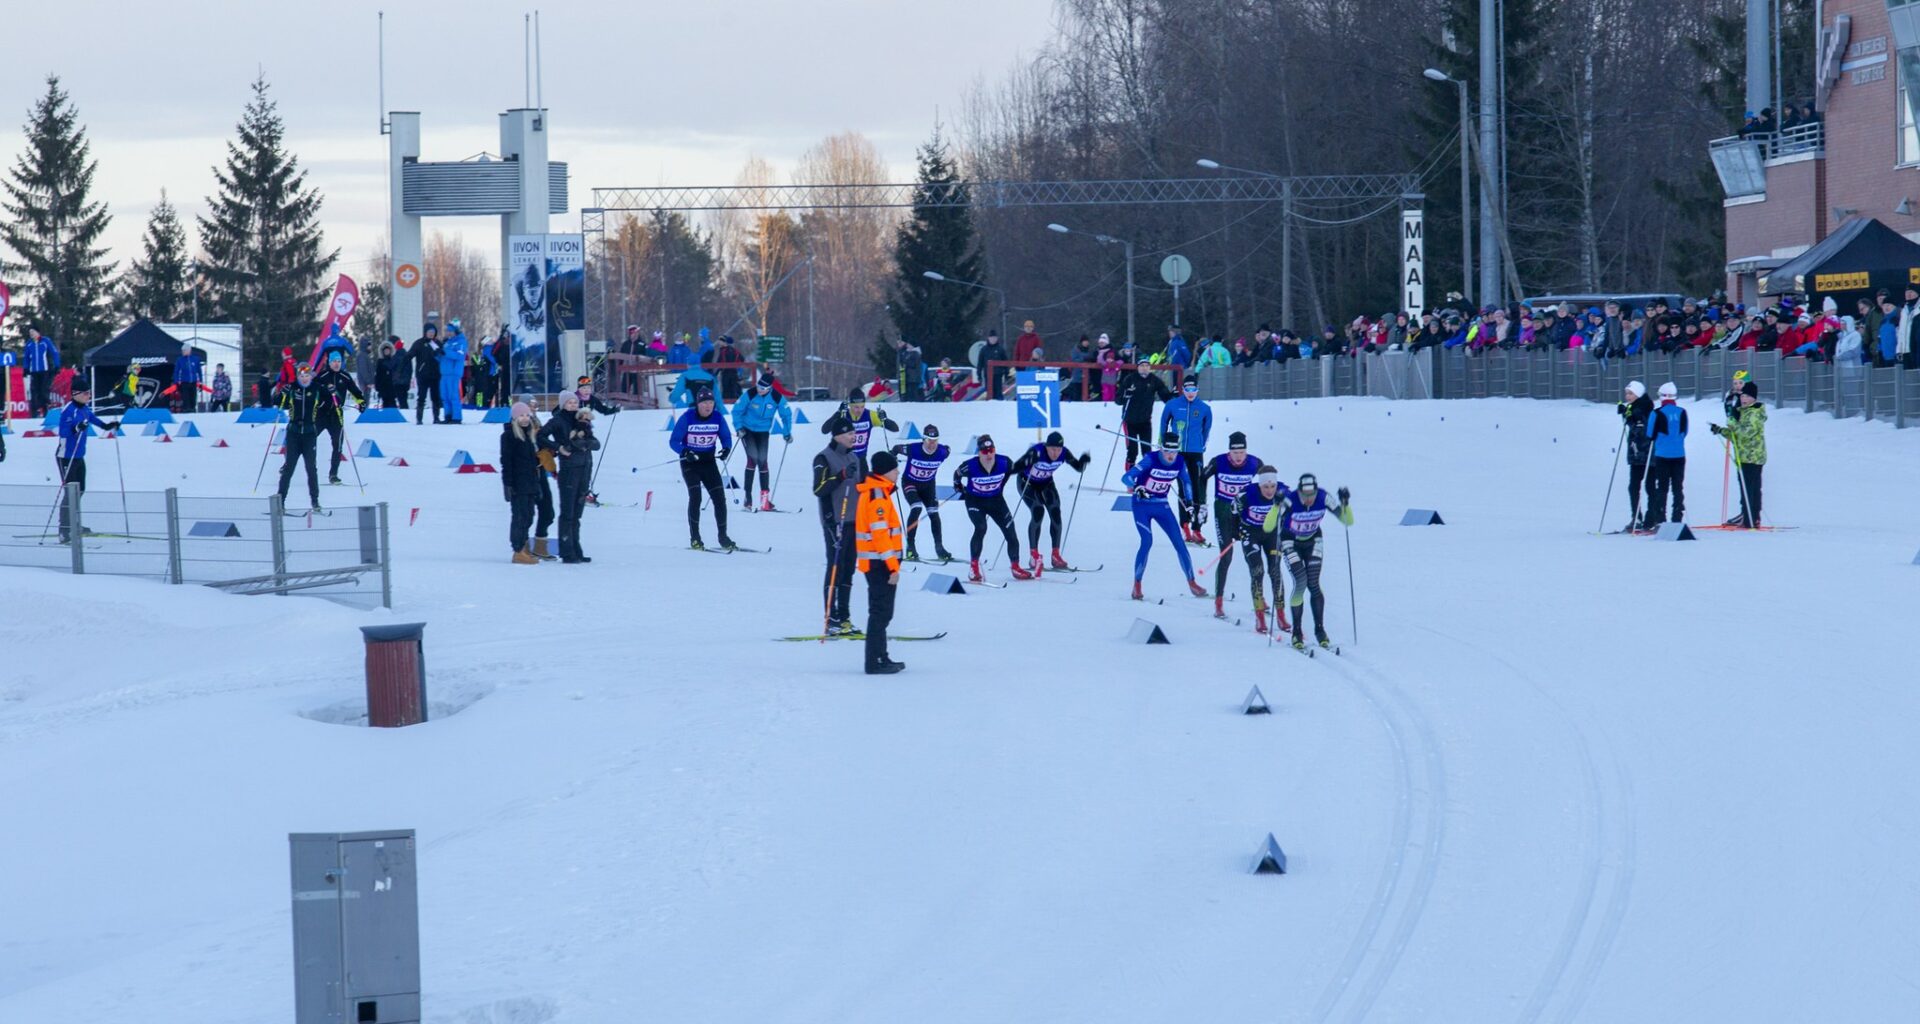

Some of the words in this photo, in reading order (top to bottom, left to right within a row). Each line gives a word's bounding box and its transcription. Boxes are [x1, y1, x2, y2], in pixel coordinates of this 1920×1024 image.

[513, 241, 540, 253] IIVON
[550, 241, 579, 253] IIVON
[1817, 278, 1867, 289] PONSSE
[693, 436, 714, 444] 137
